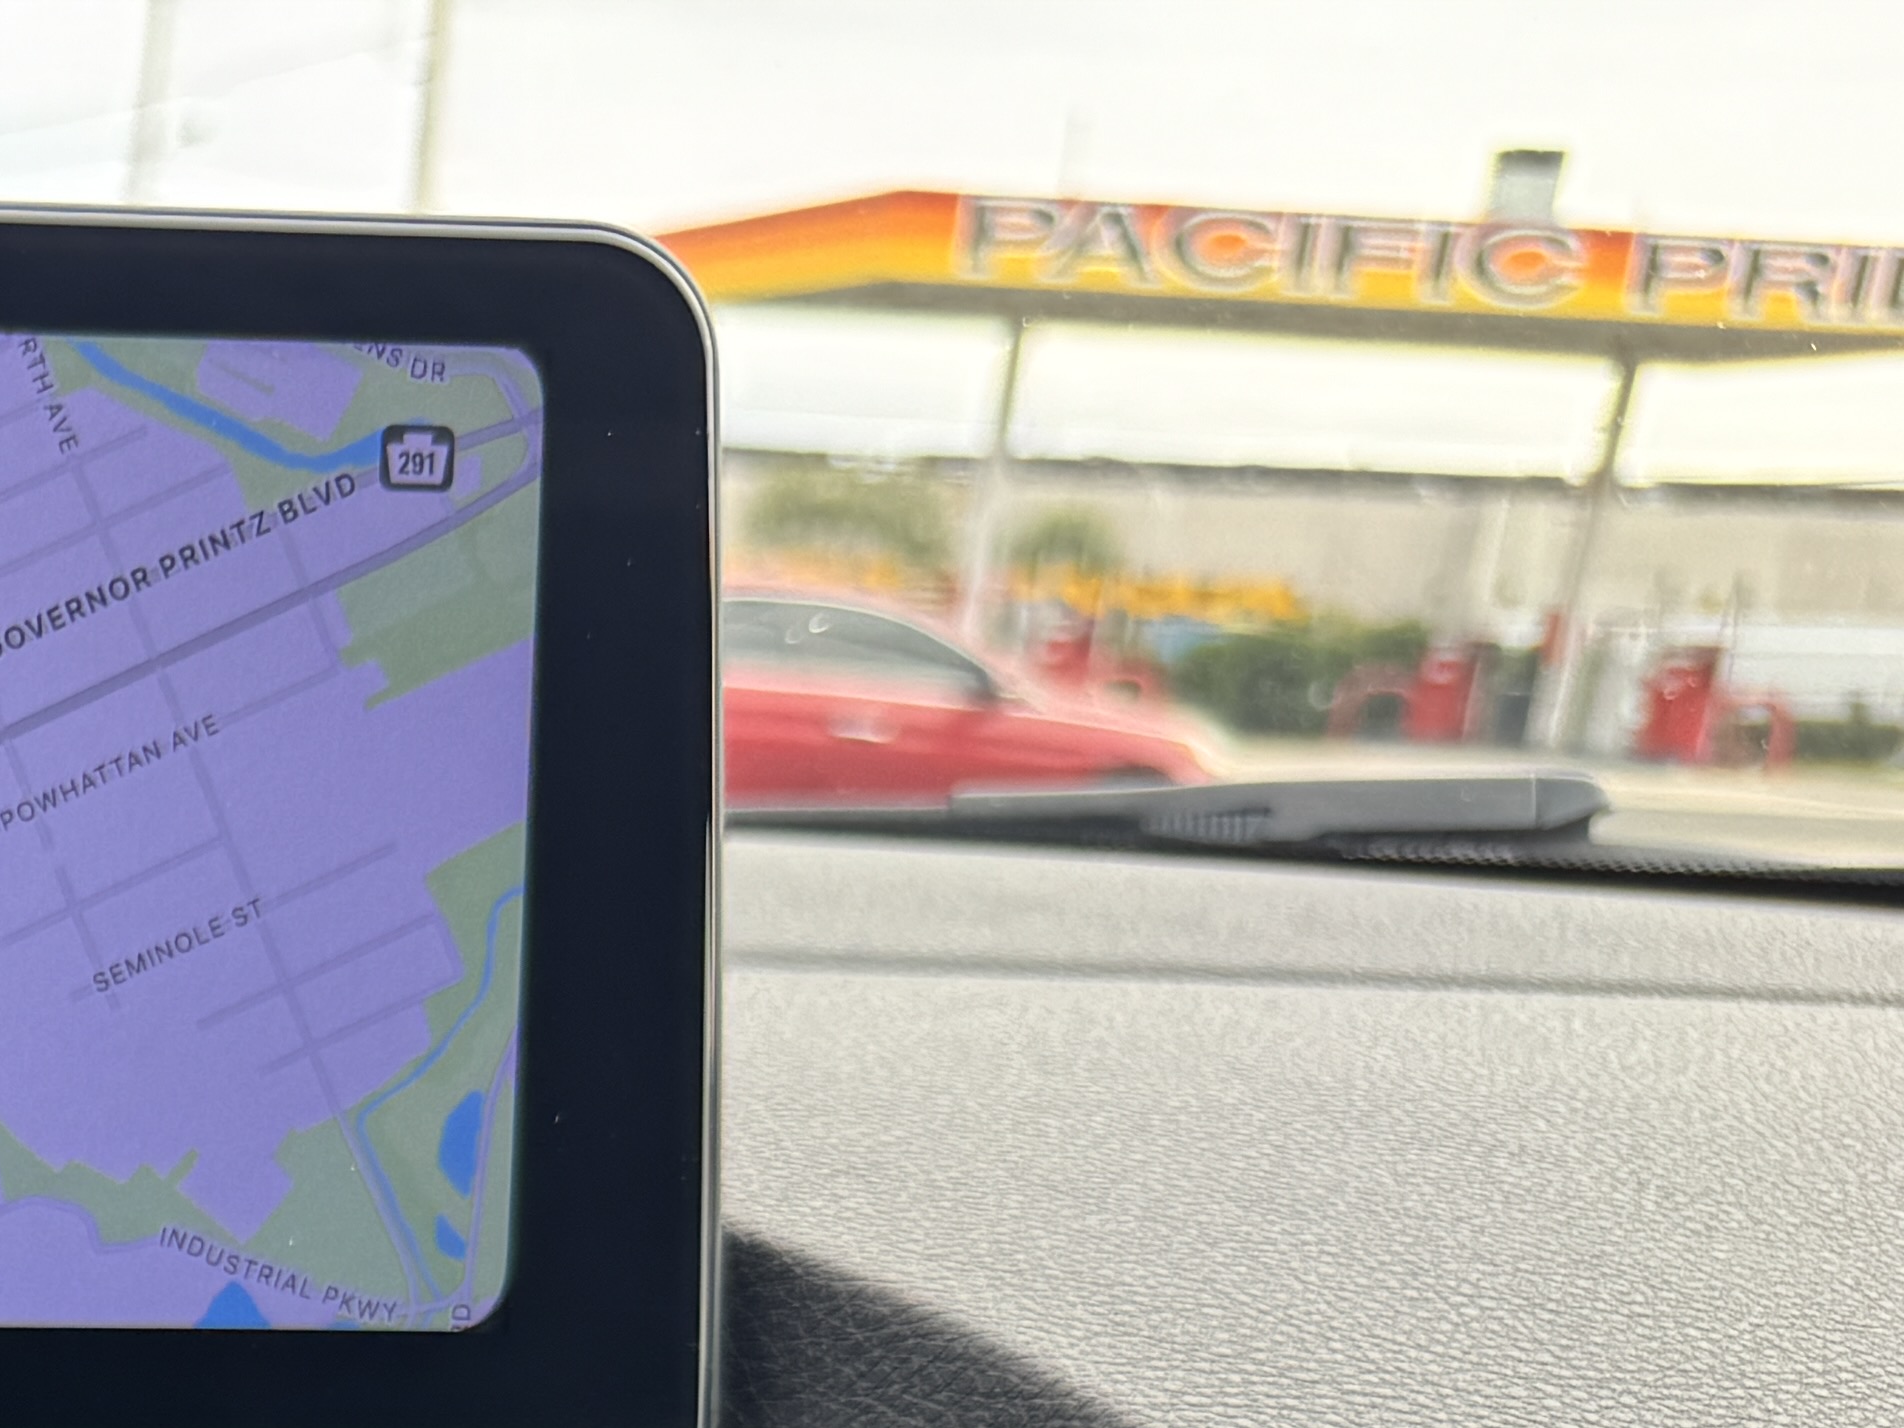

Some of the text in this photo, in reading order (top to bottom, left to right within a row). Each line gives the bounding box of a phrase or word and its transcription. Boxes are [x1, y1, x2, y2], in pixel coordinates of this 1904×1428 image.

[956, 196, 1586, 308] PACIFIC
[411, 356, 446, 381] DR
[43, 403, 79, 455] AVE
[398, 451, 436, 476] 291
[158, 510, 273, 582] PRINTZ
[278, 472, 357, 525] BLVD
[0, 713, 221, 832] POWHATTAN AVE
[92, 898, 265, 993] SEMINOLE ST
[159, 1226, 397, 1323] INDUSTRIAL PKWY
